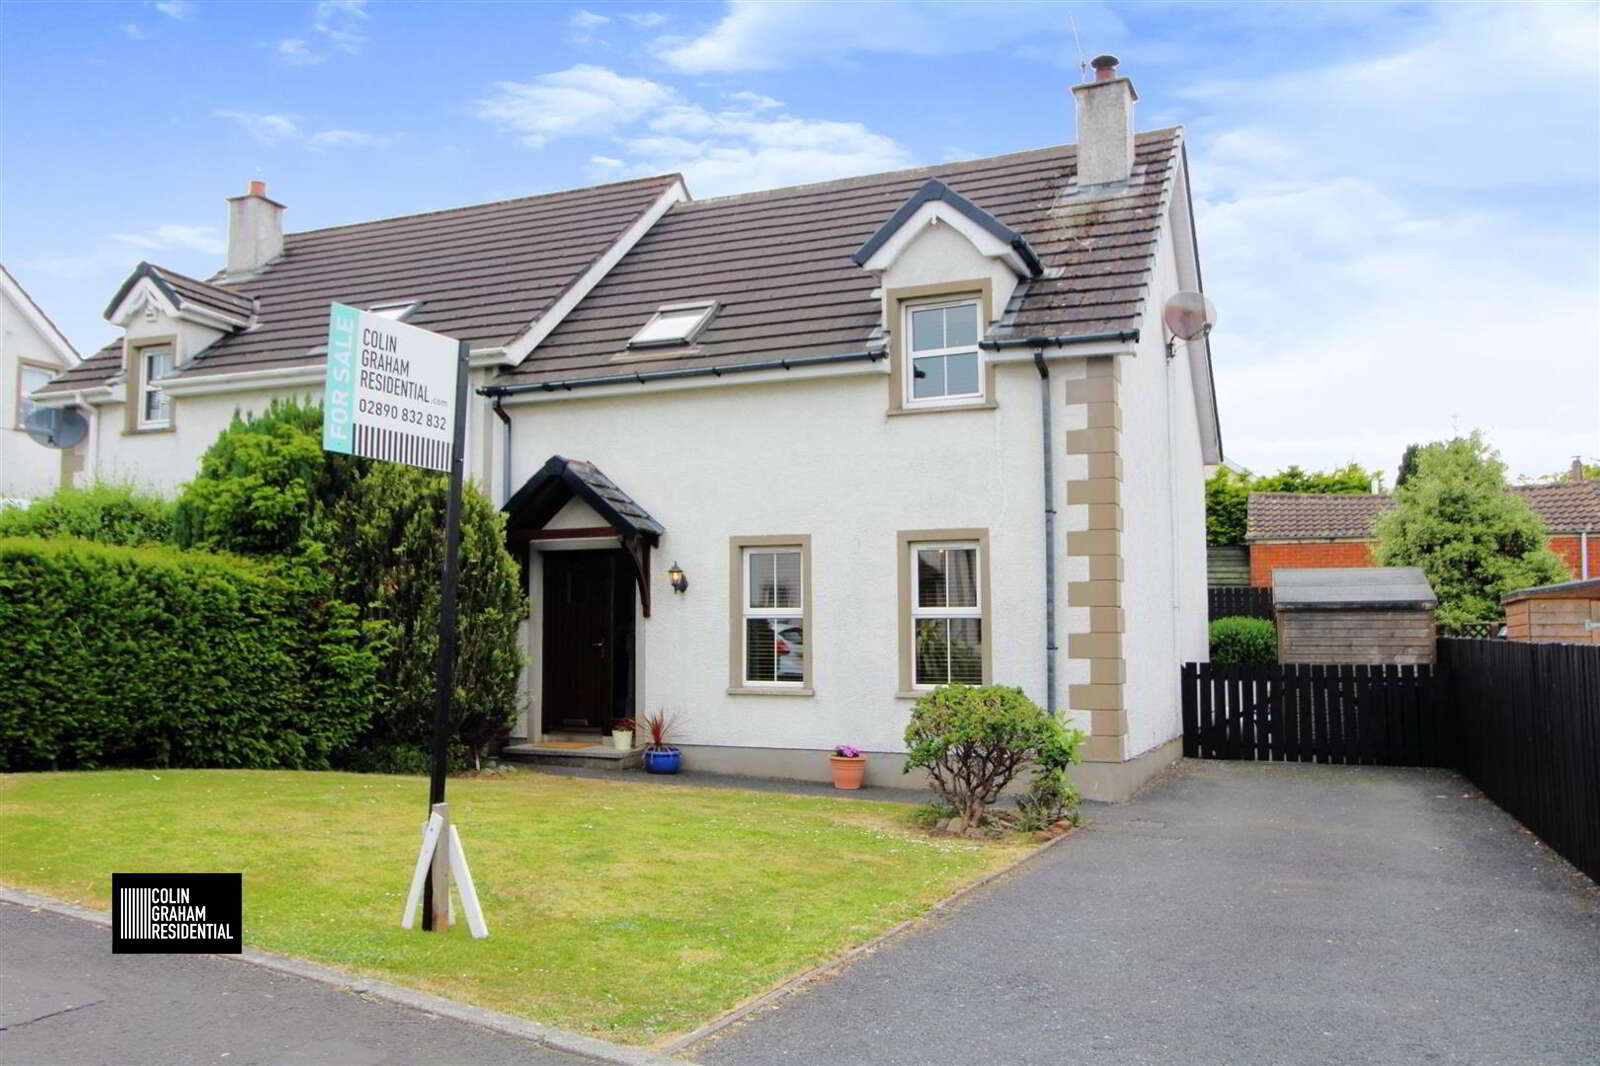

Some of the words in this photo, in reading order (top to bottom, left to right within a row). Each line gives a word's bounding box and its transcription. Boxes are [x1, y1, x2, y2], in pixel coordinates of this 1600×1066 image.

[334, 317, 352, 384] SALE
[362, 328, 397, 353] COLIN
[361, 349, 410, 377] GRAHAM
[331, 392, 349, 440] FOR
[359, 399, 398, 420] 02890
[401, 408, 423, 425] 832
[426, 414, 447, 430] 832
